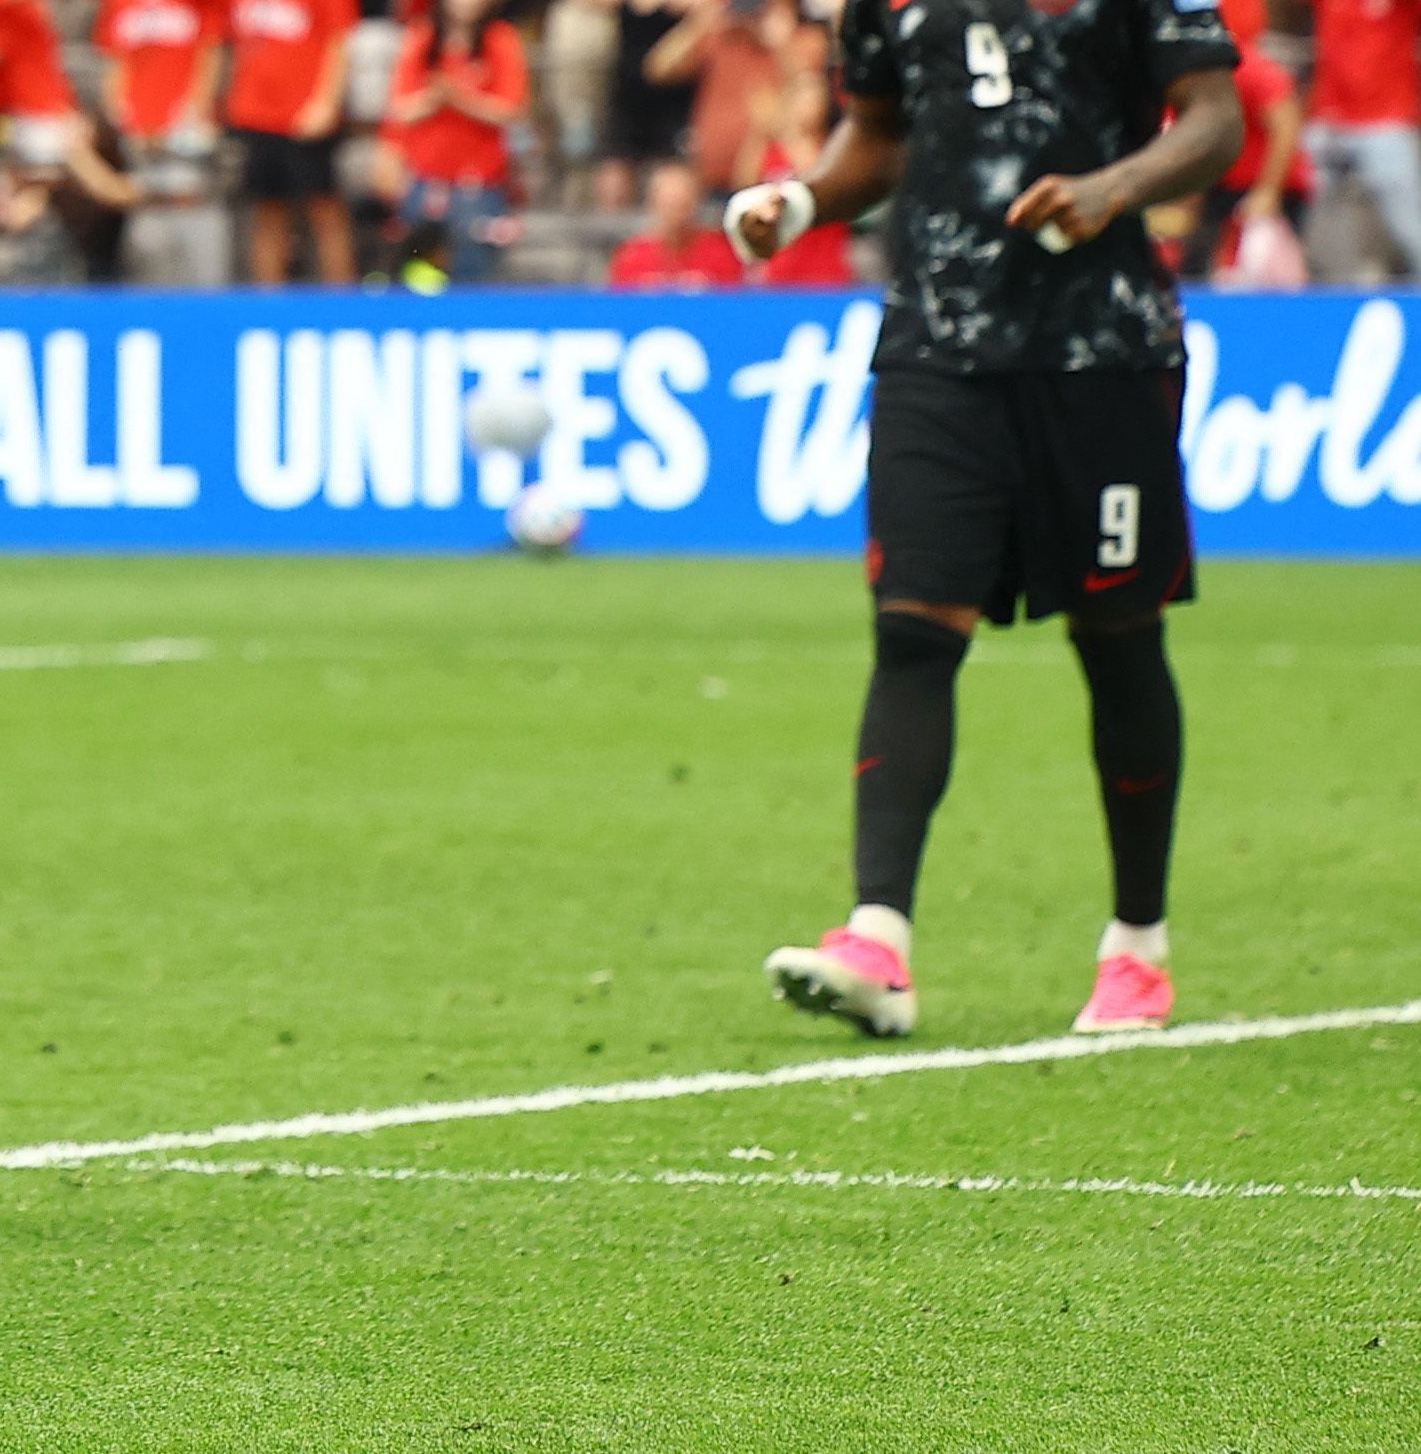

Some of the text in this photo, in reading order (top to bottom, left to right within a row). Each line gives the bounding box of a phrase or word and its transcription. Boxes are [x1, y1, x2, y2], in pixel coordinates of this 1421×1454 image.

[964, 22, 1014, 109] 9
[233, 327, 711, 512] UNITES
[727, 298, 883, 526] th
[1177, 298, 1421, 513] orl
[1097, 483, 1140, 568] 9
